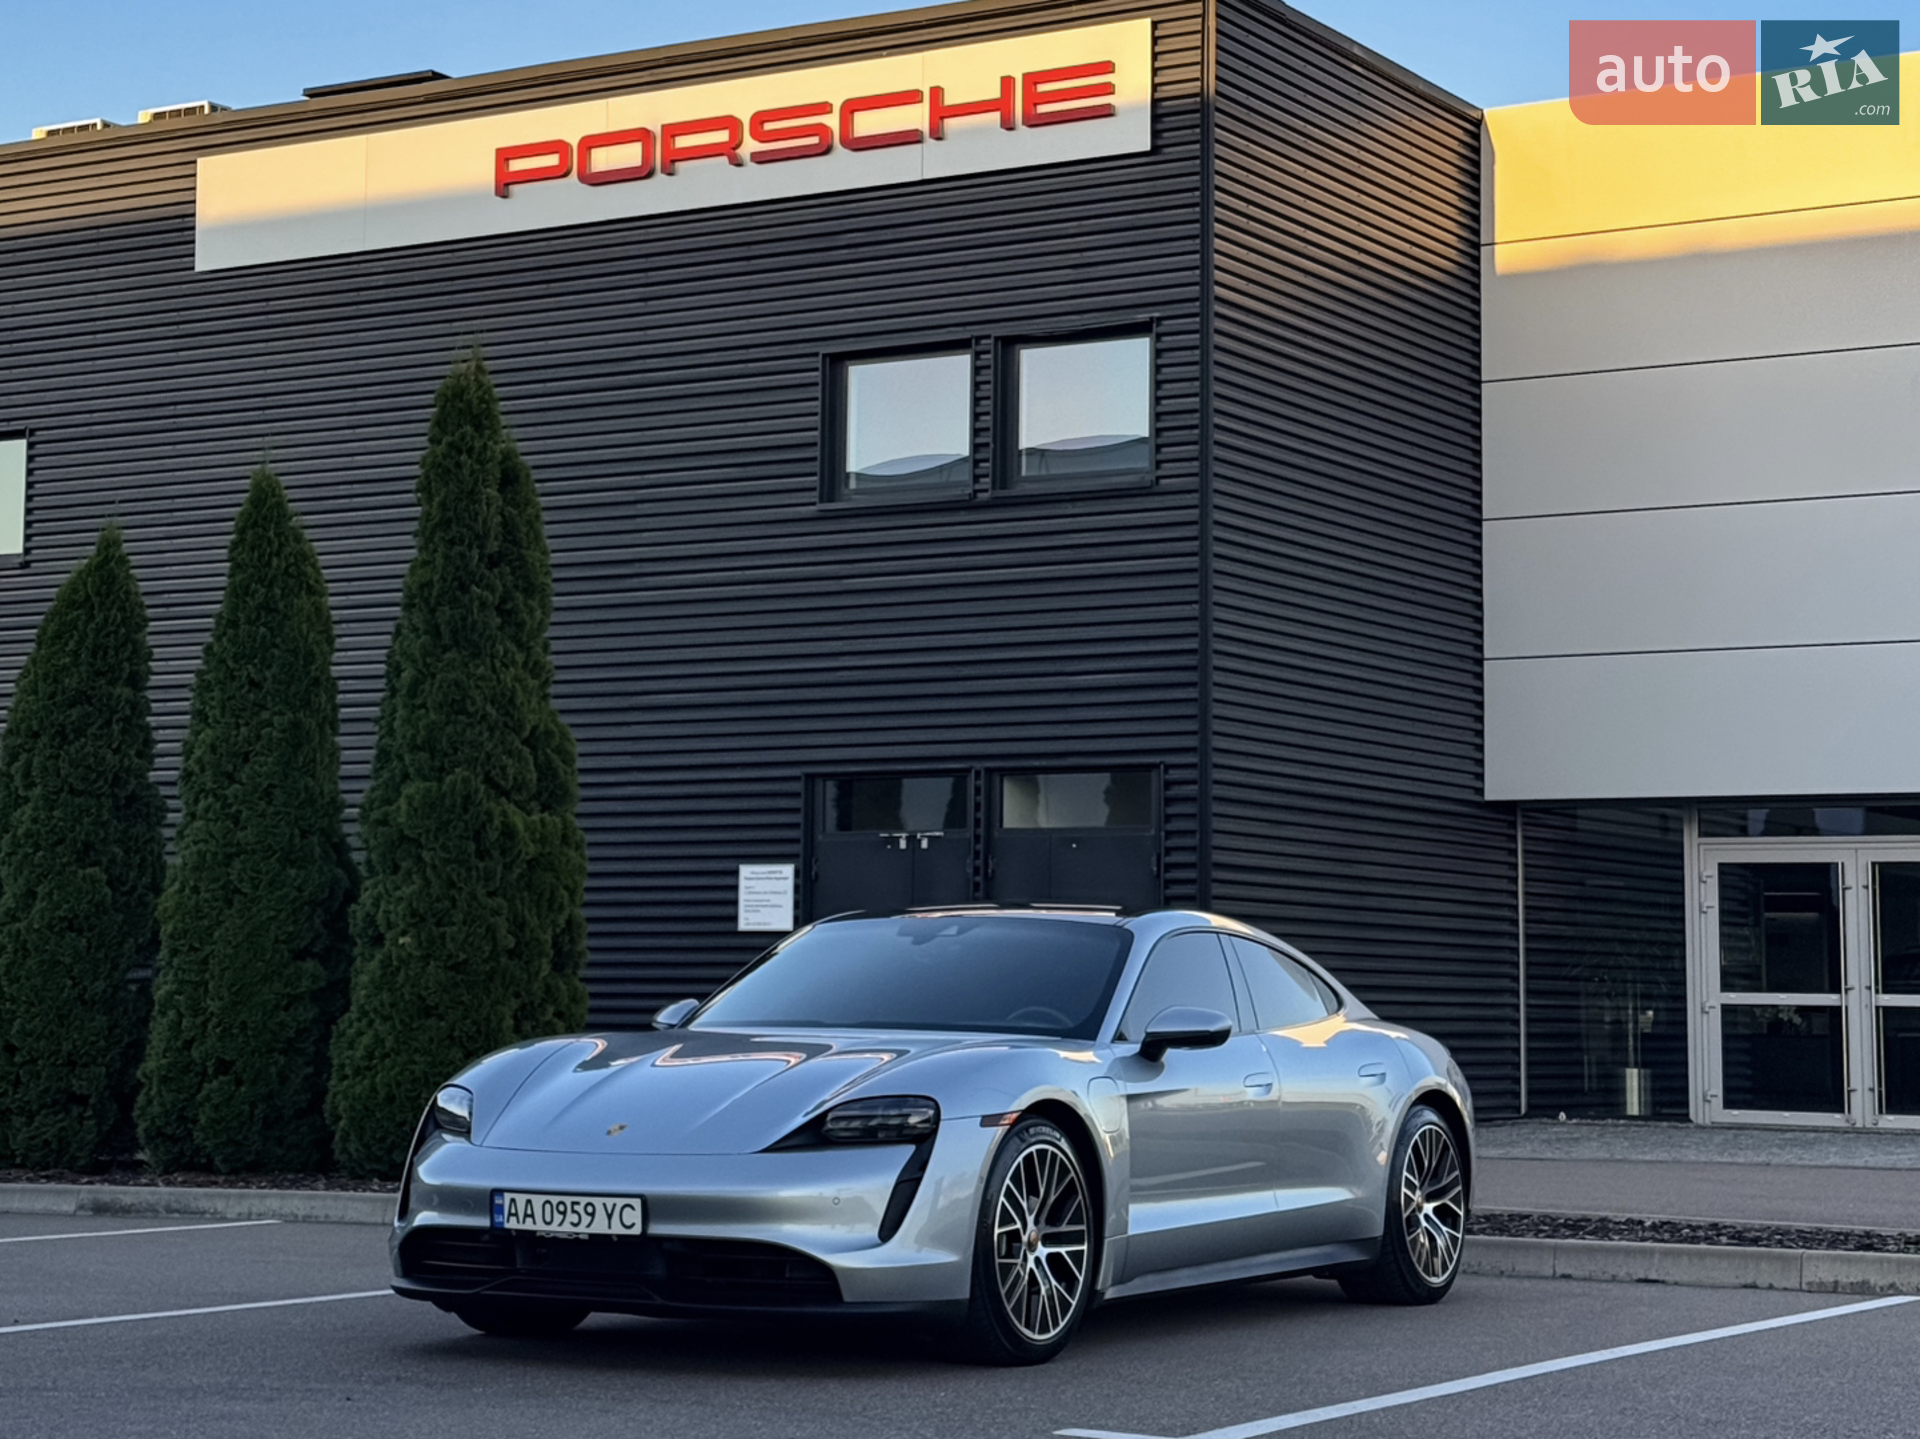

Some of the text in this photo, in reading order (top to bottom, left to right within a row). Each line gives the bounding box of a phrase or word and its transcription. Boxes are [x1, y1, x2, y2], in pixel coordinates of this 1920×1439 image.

[494, 60, 1116, 198] PORSCHE
[506, 1197, 637, 1230] AA 0959 YC
